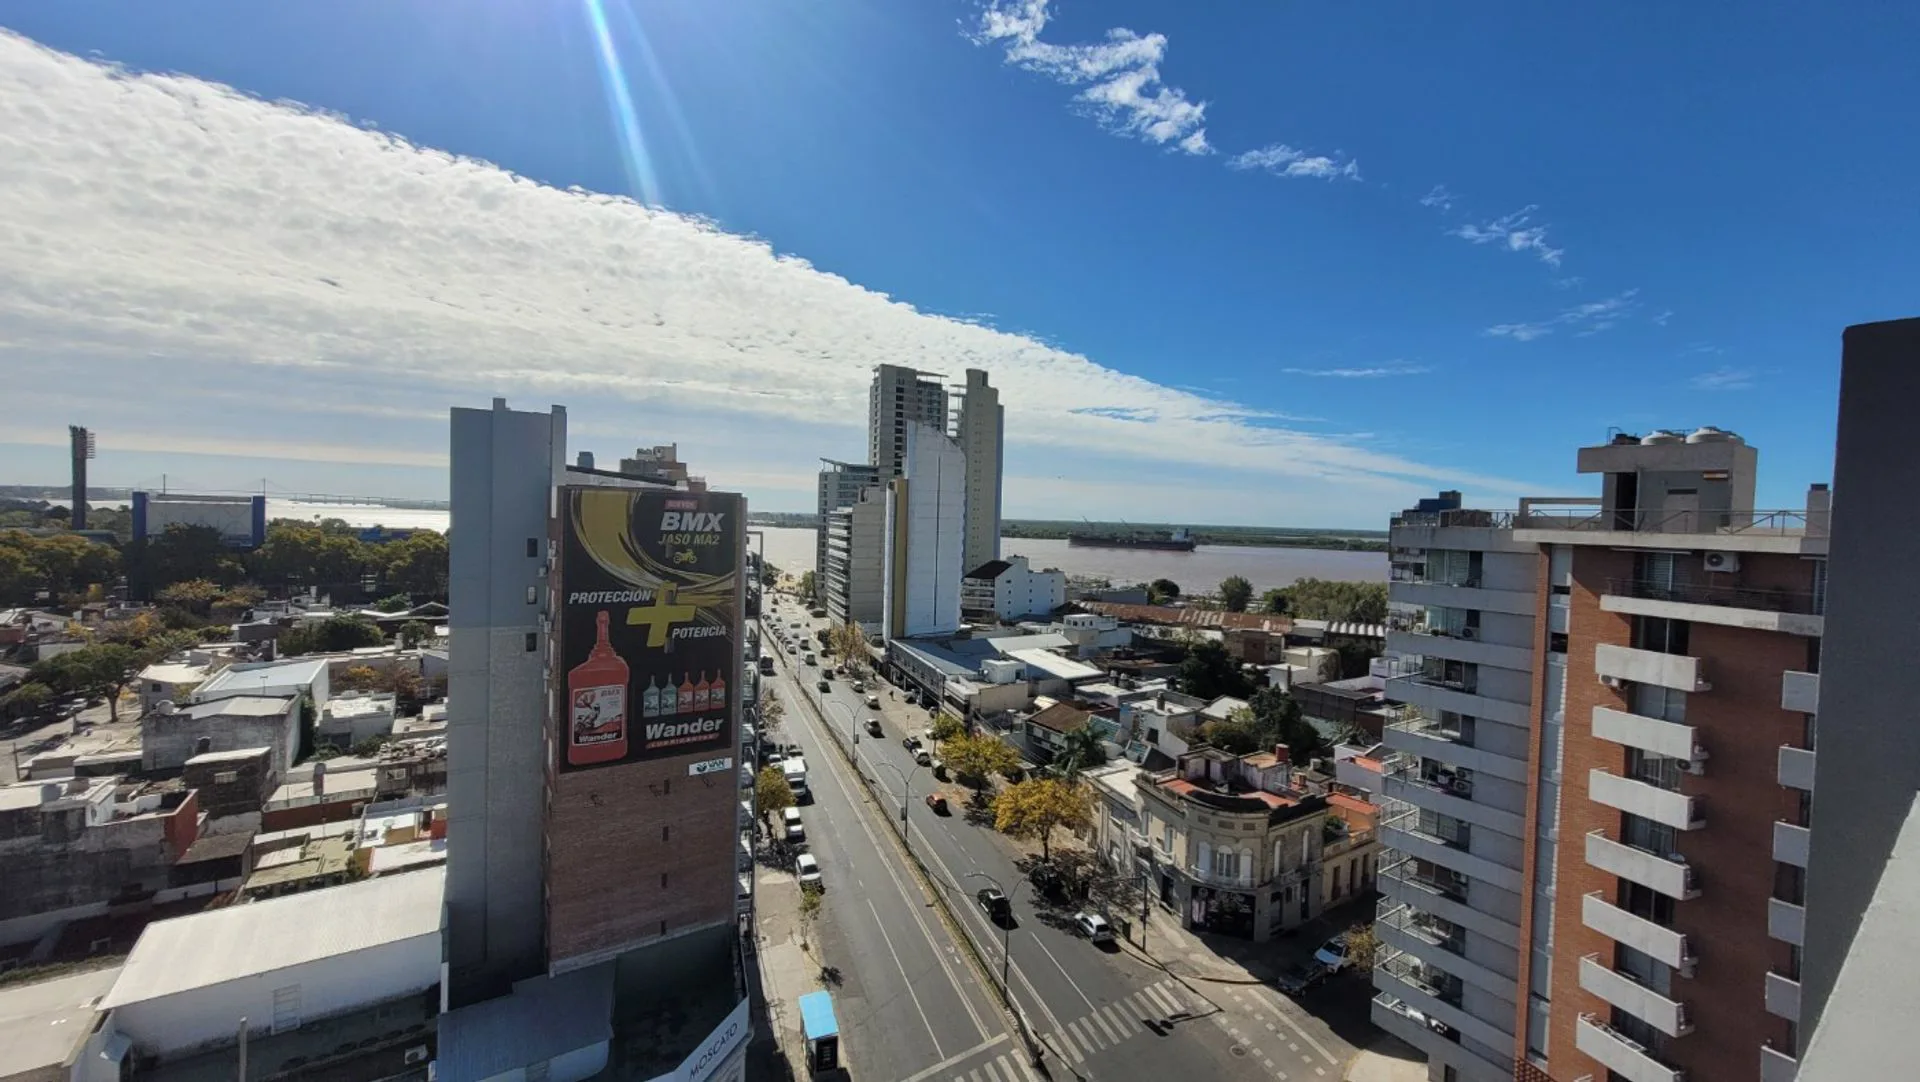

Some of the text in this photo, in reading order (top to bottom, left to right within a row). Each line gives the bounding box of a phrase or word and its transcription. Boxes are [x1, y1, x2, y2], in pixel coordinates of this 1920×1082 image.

[659, 511, 725, 532] BMX
[657, 533, 720, 545] JASO MA2
[672, 625, 727, 639] POTENCIA
[646, 716, 724, 740] Wander
[688, 1022, 738, 1080] MOSCATO
